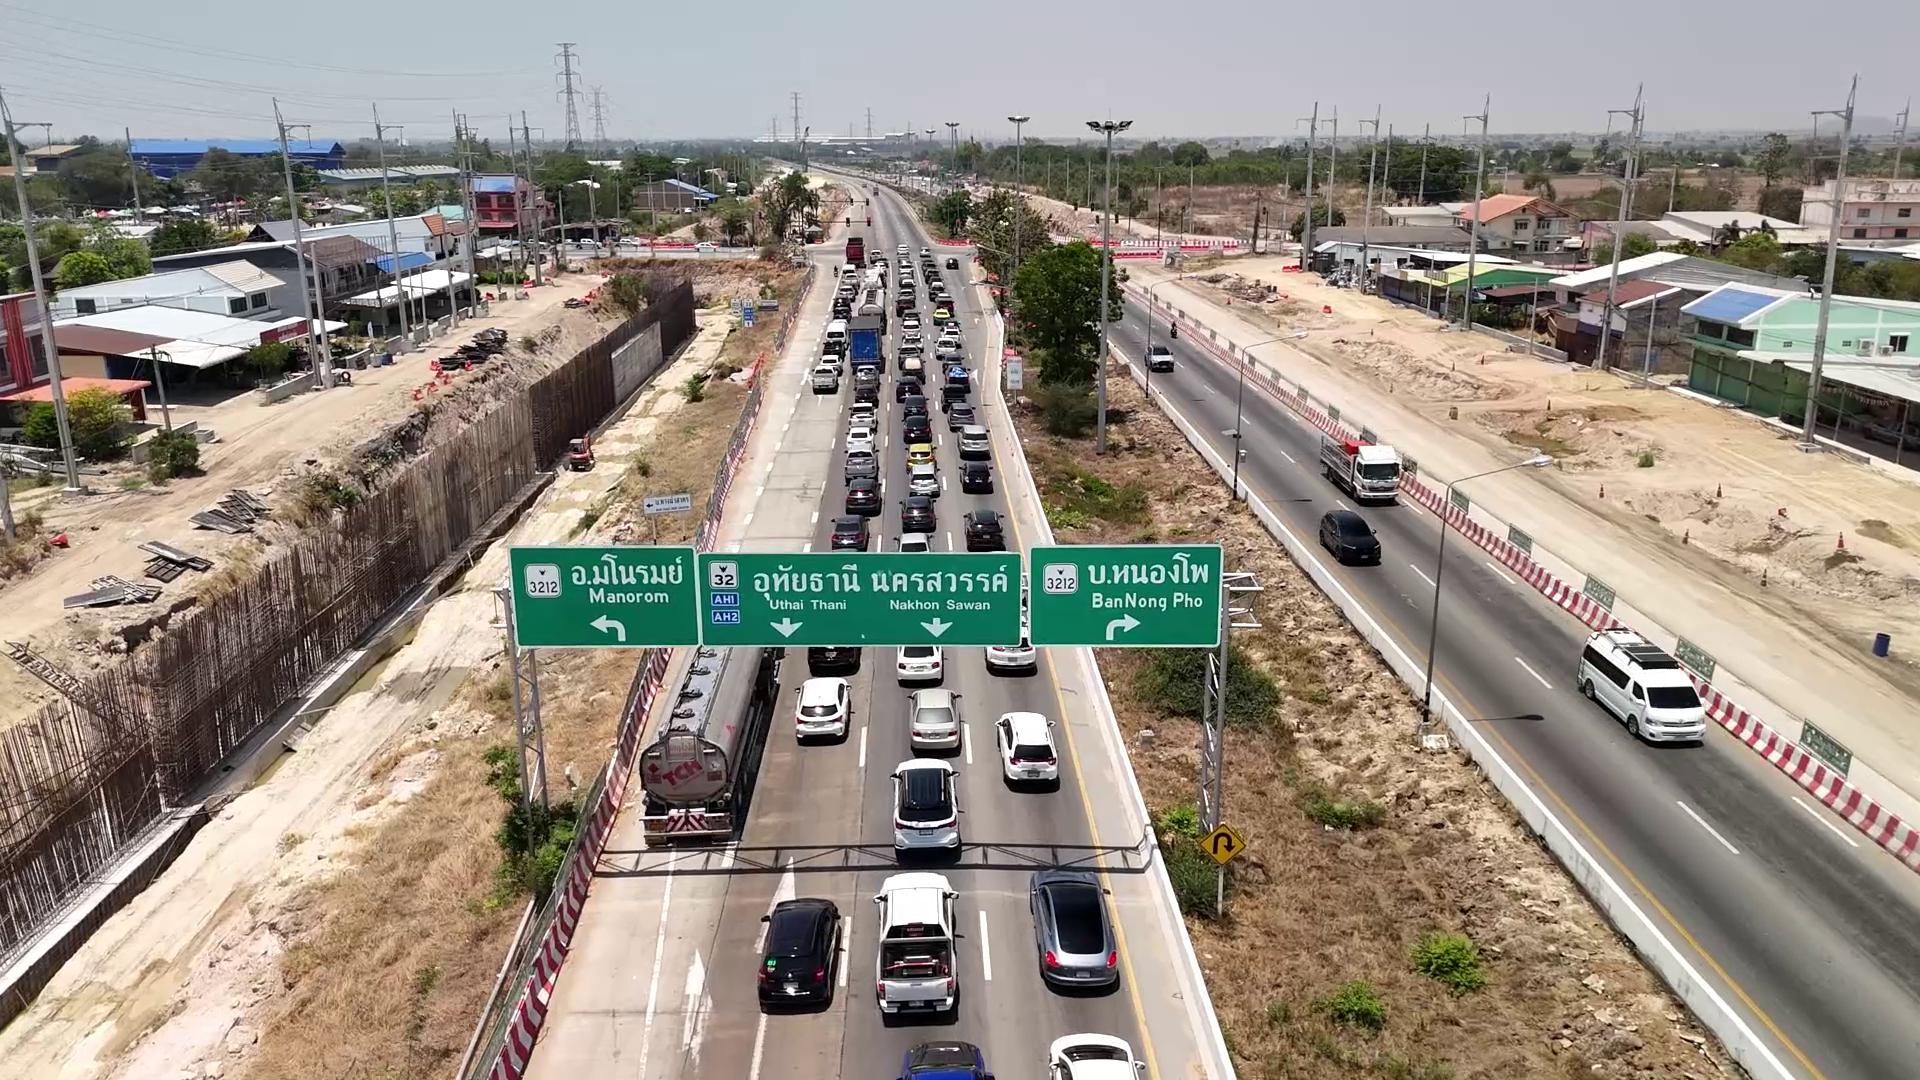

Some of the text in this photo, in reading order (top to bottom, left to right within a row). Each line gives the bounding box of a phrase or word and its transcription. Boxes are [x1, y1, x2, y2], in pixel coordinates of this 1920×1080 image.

[571, 553, 683, 585] อ.มโนรมย์
[1088, 552, 1208, 584] บ.หนองโพ
[714, 574, 734, 586] 32
[753, 563, 1008, 600] อุทัยธานี นครสวรรค์
[1047, 577, 1075, 589] 3212
[529, 581, 558, 593] 3212
[589, 588, 669, 603] Manorom
[714, 595, 735, 604] AH1
[1173, 592, 1203, 608] Pho
[769, 600, 847, 610] Uthai Thani
[890, 600, 990, 610] Nakhon Sawan
[714, 612, 738, 621] AH2
